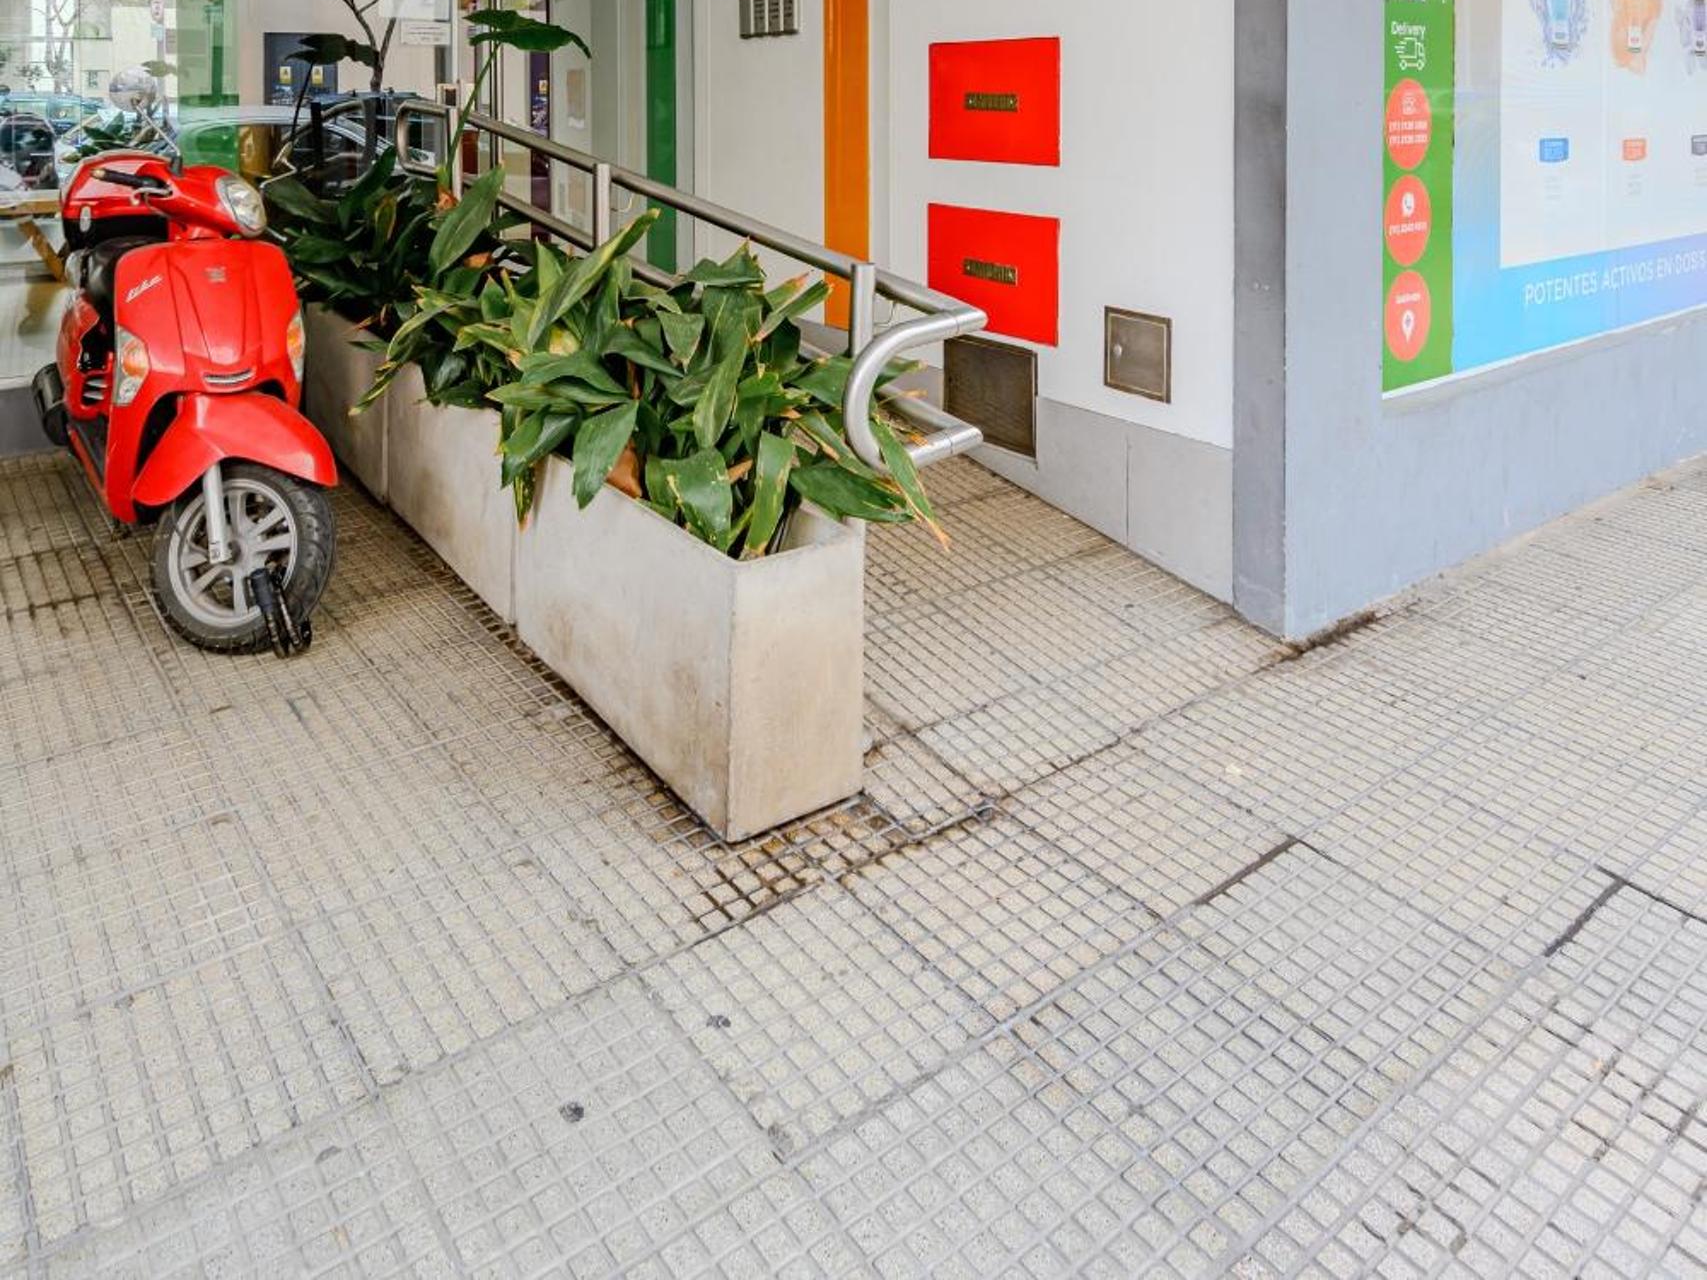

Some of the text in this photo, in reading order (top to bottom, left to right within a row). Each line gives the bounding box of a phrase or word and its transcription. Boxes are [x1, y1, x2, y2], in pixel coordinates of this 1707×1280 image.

[1391, 20, 1426, 40] Delivery
[1524, 270, 1598, 306] POTENTES
[1602, 260, 1654, 290] ACTIVOS
[1657, 255, 1674, 278] EN
